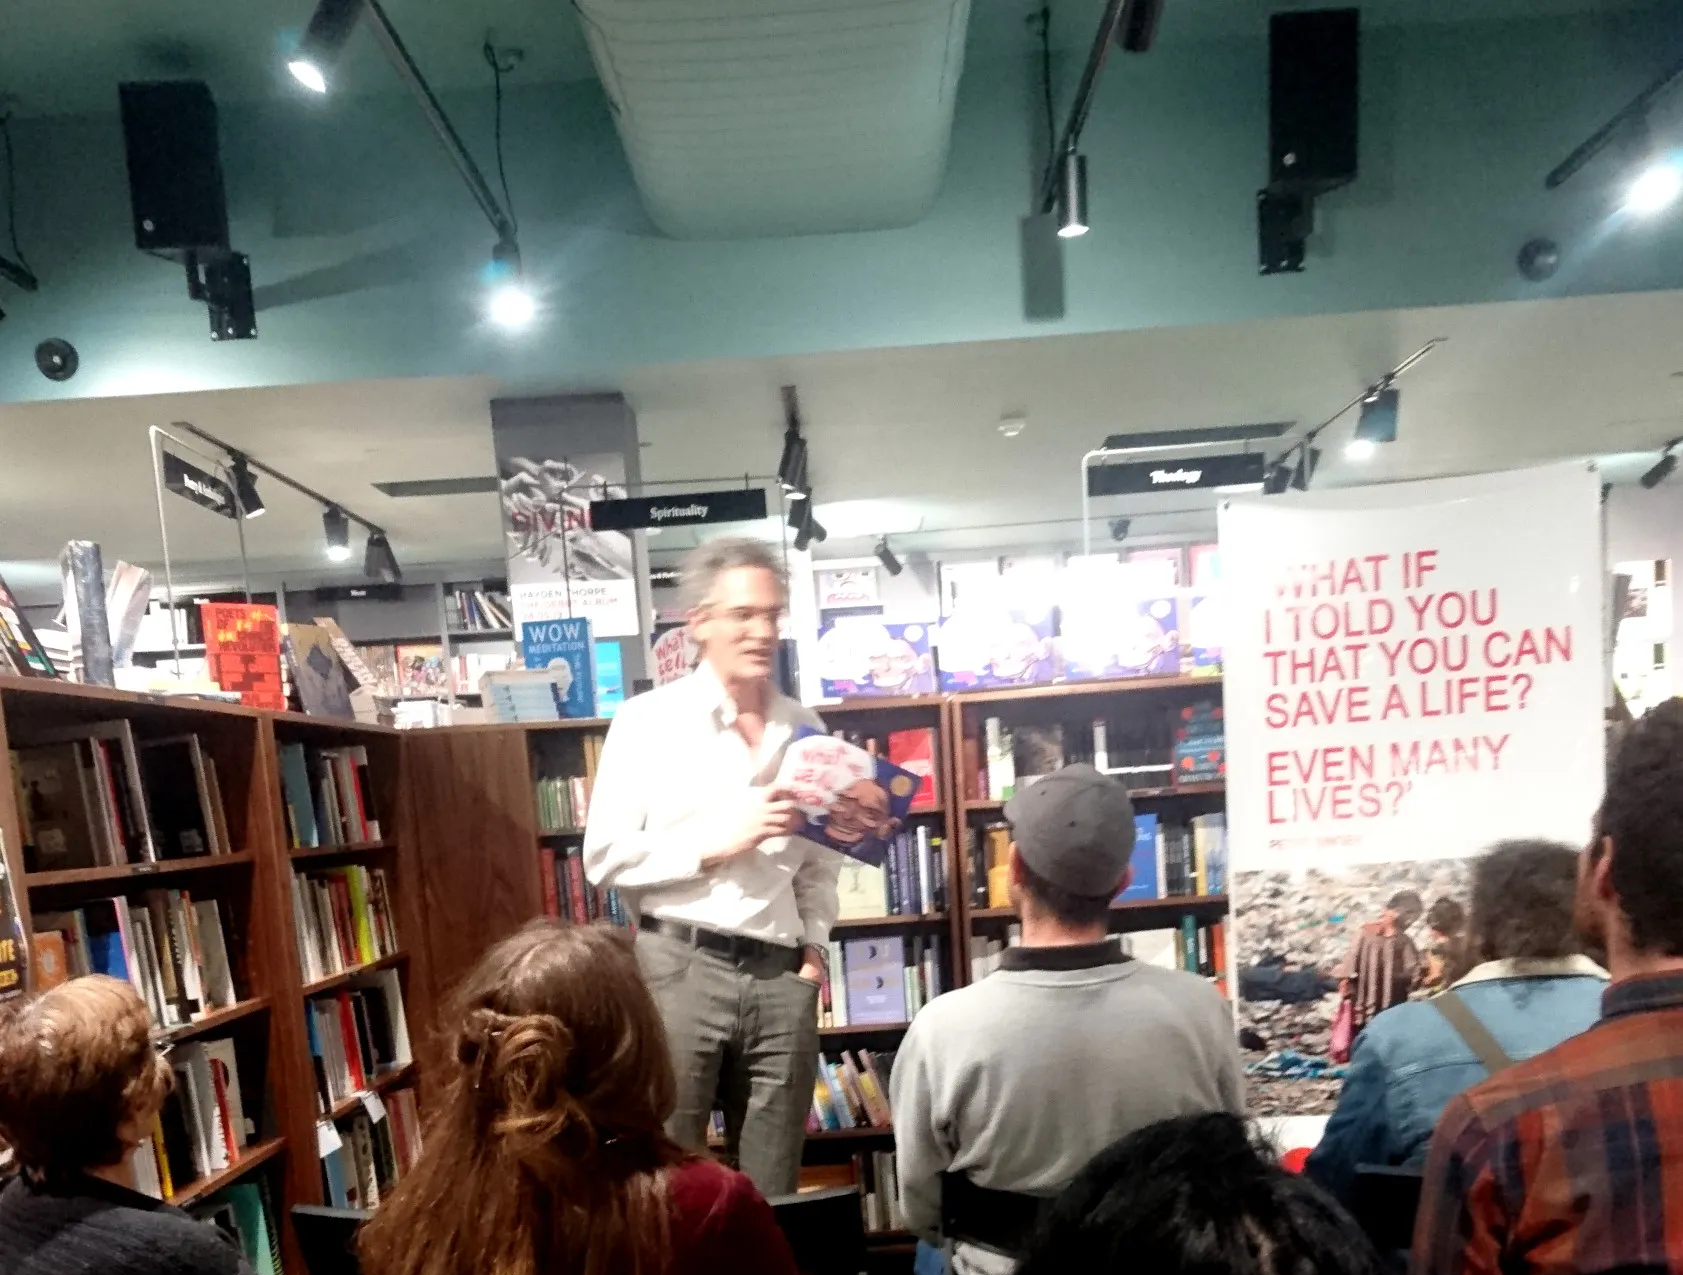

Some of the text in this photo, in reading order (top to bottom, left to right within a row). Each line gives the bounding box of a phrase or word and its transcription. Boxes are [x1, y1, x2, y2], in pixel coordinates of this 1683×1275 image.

[650, 504, 709, 521] Spirituality
[1275, 549, 1439, 598] WHAT IF
[528, 621, 582, 644] WOW
[1264, 587, 1498, 644] I TOLD YOU
[528, 641, 586, 655] MEDITATION
[1263, 625, 1573, 686] THAT YOU CAN
[1265, 672, 1534, 729] SAVE A LIFE?
[1267, 733, 1511, 786] EVEN MANY
